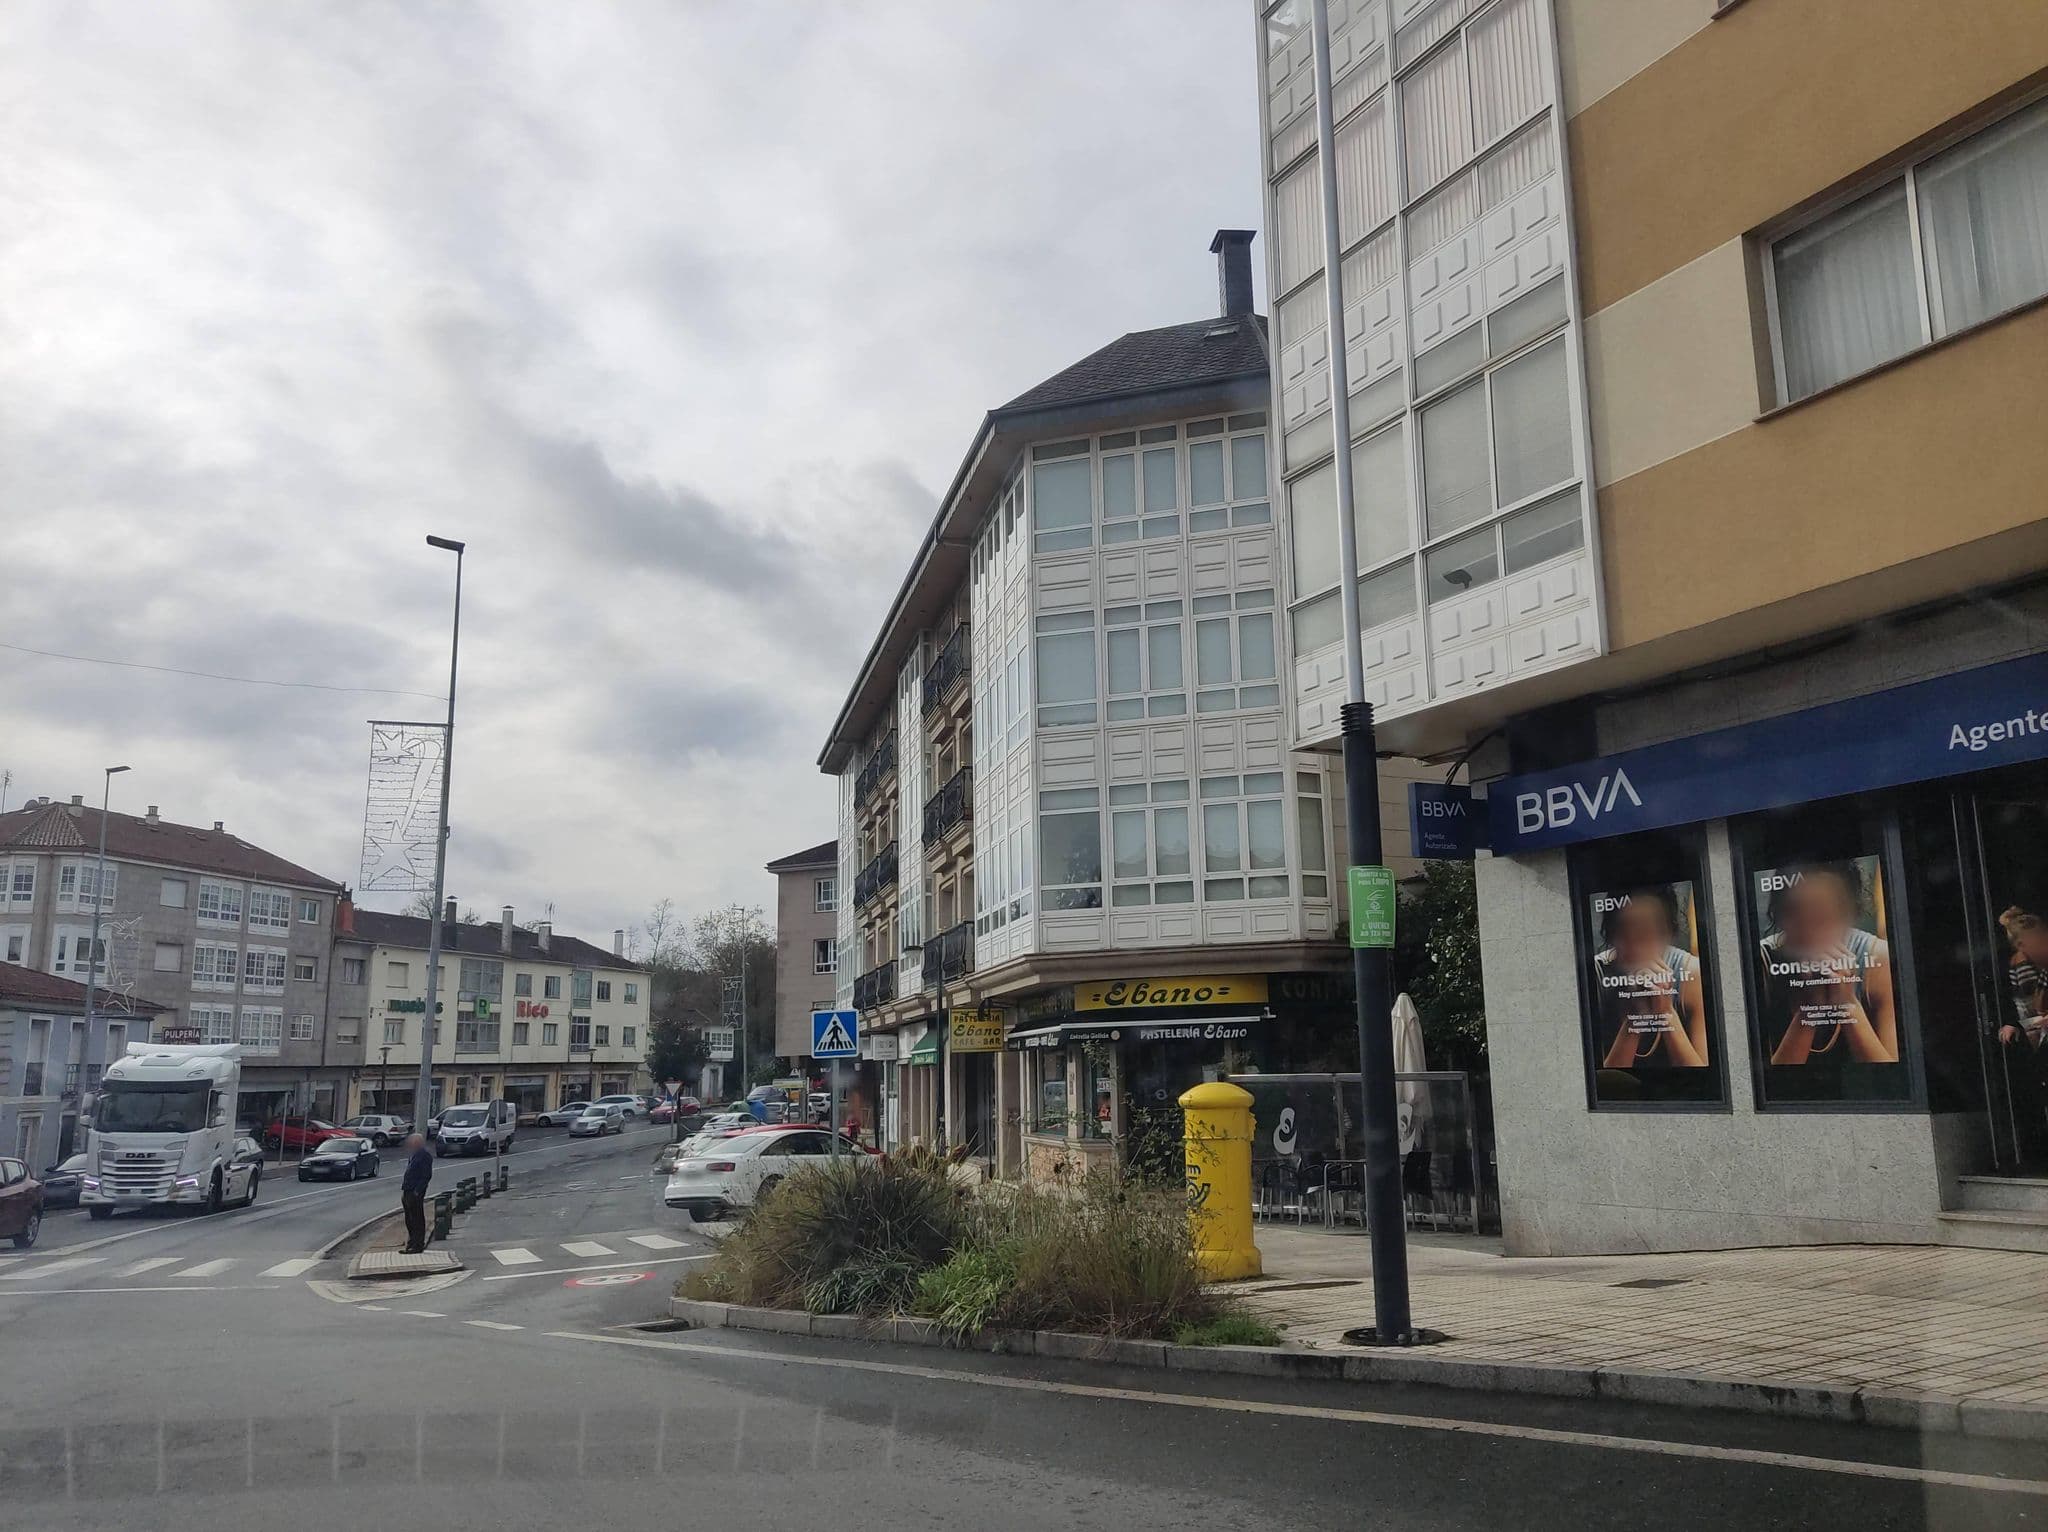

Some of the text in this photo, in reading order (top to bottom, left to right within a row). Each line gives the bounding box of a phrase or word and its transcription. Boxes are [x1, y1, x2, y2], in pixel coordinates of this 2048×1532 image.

[1421, 800, 1466, 817] BBVA
[1516, 767, 1642, 834] BBVA
[1761, 872, 1805, 892] BBVA
[1595, 894, 1632, 913] BBVA
[1770, 952, 1882, 976] conseguir. ir.
[1602, 967, 1694, 988] conseguir. ir.
[1789, 975, 1863, 987] Hoy comienza todo.
[1104, 981, 1213, 1006] Ebano
[1618, 991, 1632, 999] Hoy
[1632, 989, 1661, 997] comienza
[387, 997, 443, 1014] muebs
[516, 1001, 549, 1018] Rico
[953, 1014, 1000, 1023] PASTEIA
[164, 1029, 200, 1039] PULPERÍA
[953, 1024, 1001, 1037] Ebano
[1203, 1024, 1247, 1039] Ebano
[983, 1037, 1001, 1045] BAR
